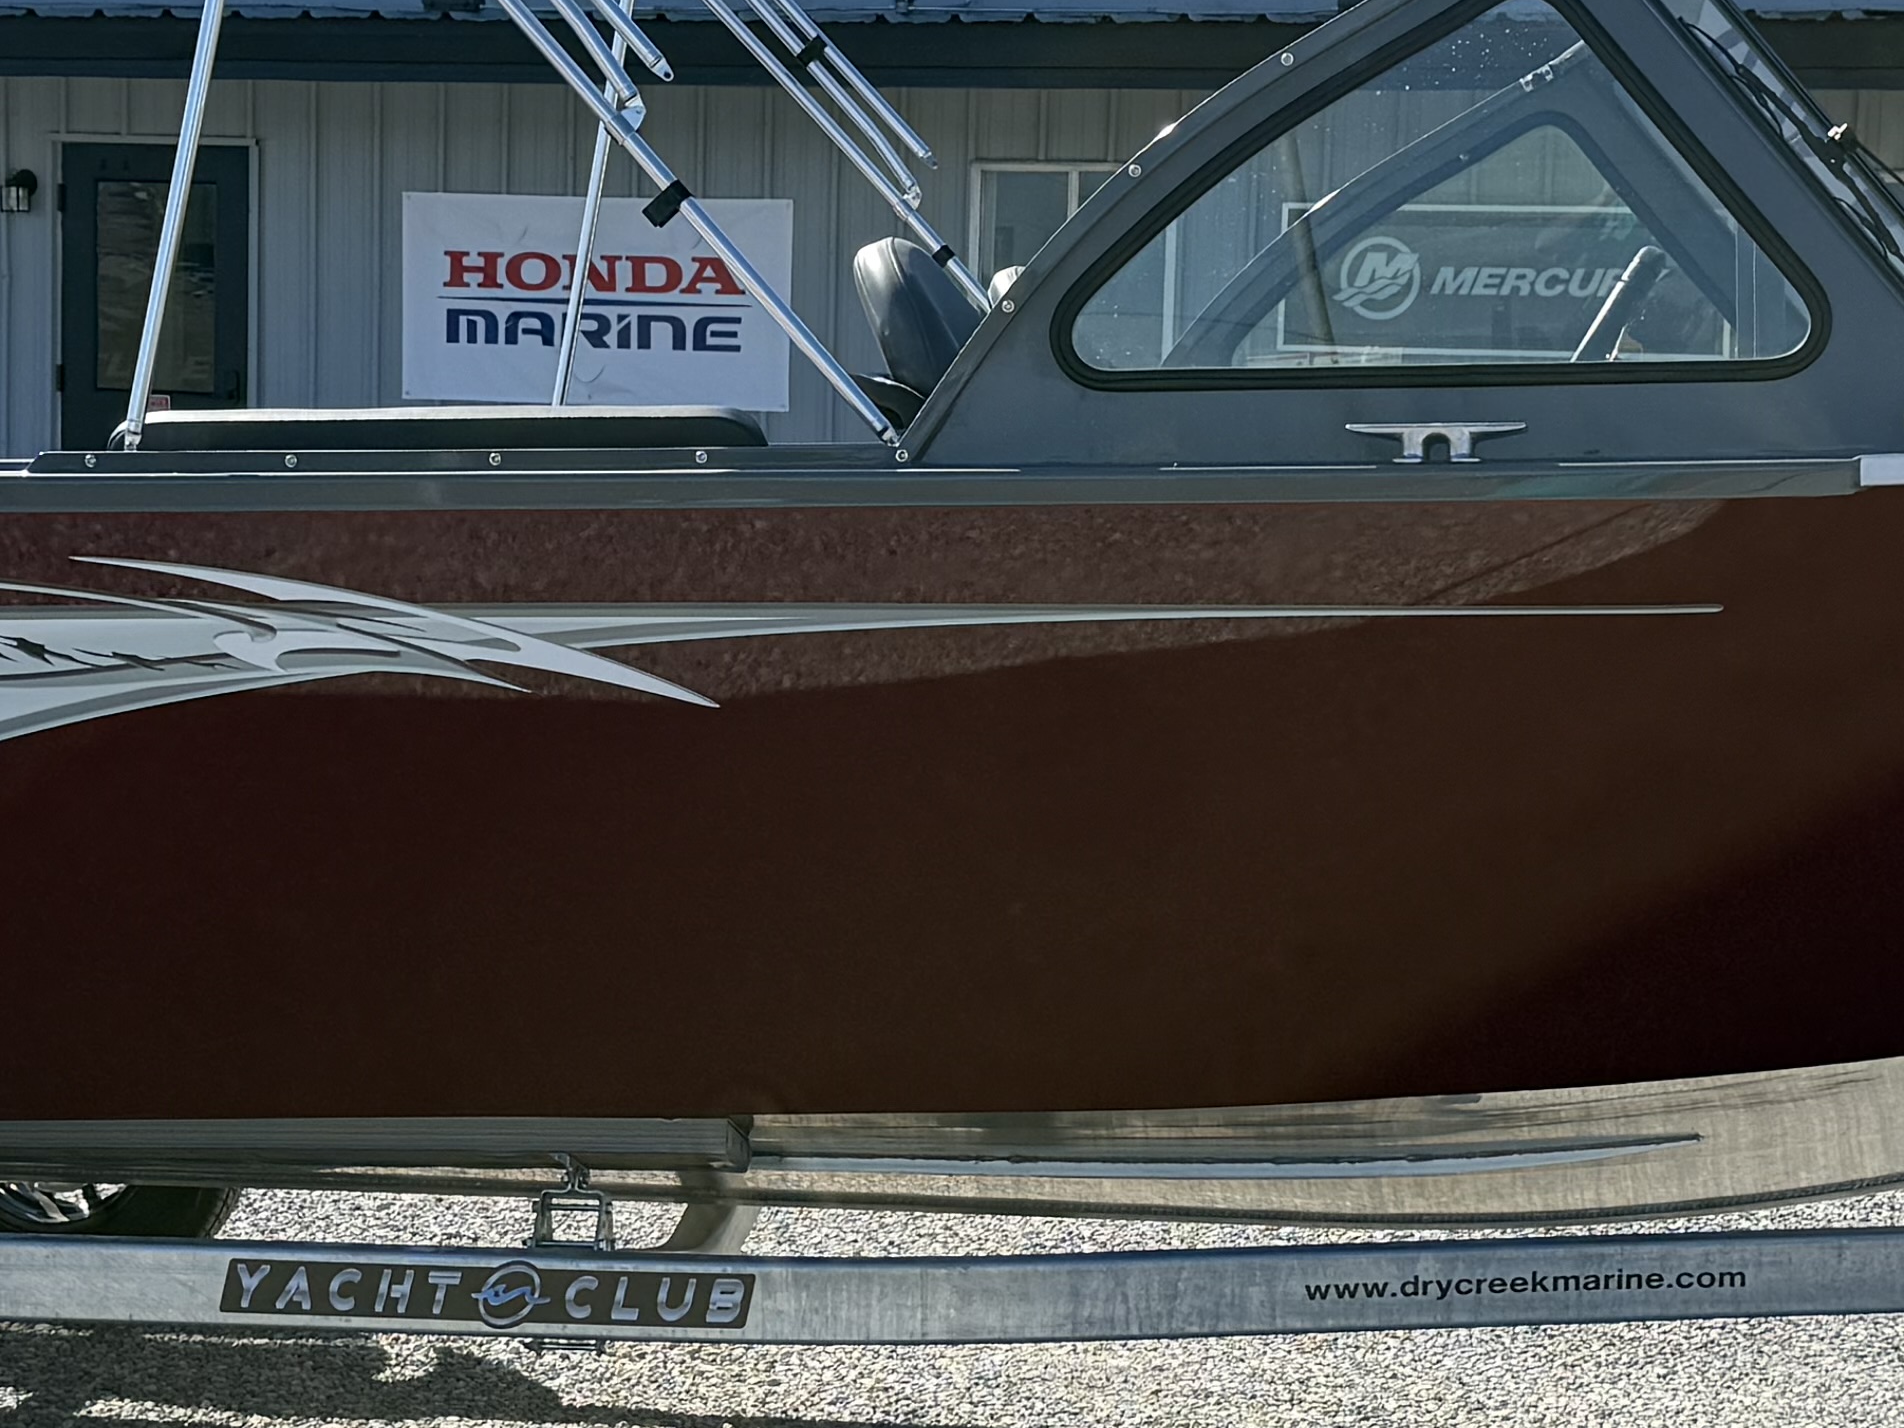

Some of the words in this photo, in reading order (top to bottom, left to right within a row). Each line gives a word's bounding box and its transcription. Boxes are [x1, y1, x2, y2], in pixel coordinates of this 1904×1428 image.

[443, 250, 746, 295] HONDA
[1430, 266, 1670, 298] MERCU
[446, 308, 742, 353] MARINE
[237, 1263, 462, 1314] YACHT
[565, 1276, 746, 1324] CLUB
[1305, 1268, 1746, 1300] www.drycreekmarine.com
